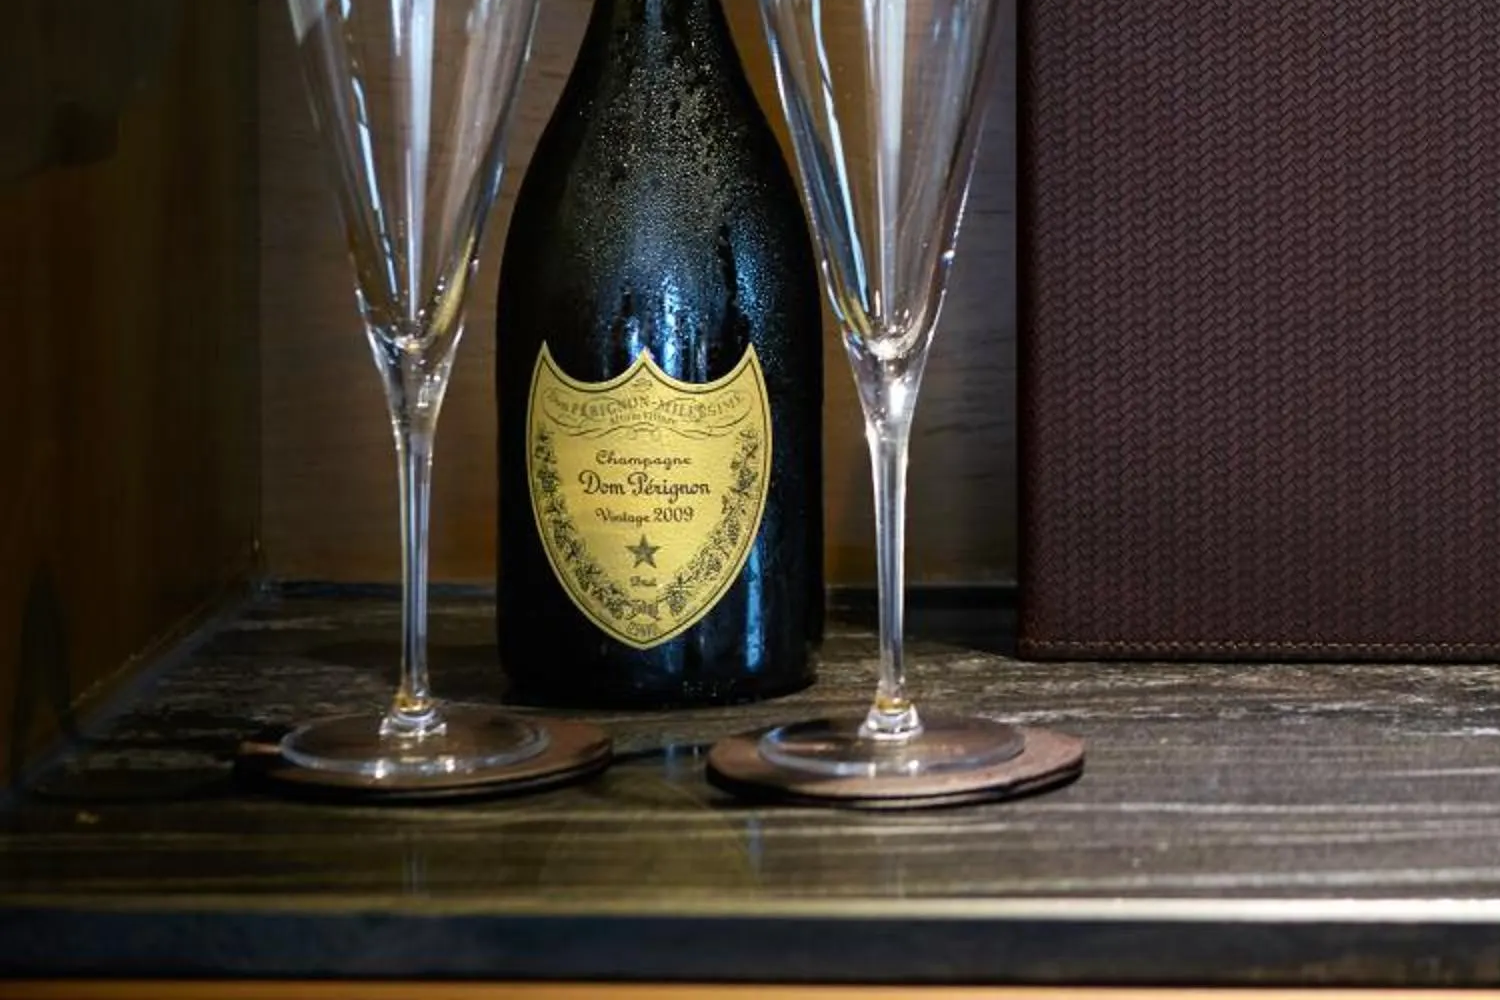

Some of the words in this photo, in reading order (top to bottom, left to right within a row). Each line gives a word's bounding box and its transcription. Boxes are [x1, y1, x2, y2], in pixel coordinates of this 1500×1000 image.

[596, 449, 692, 470] Champagne
[578, 469, 626, 495] Dom
[627, 471, 711, 504] Pérignon
[594, 507, 650, 528] Vintage
[652, 505, 695, 523] 2009
